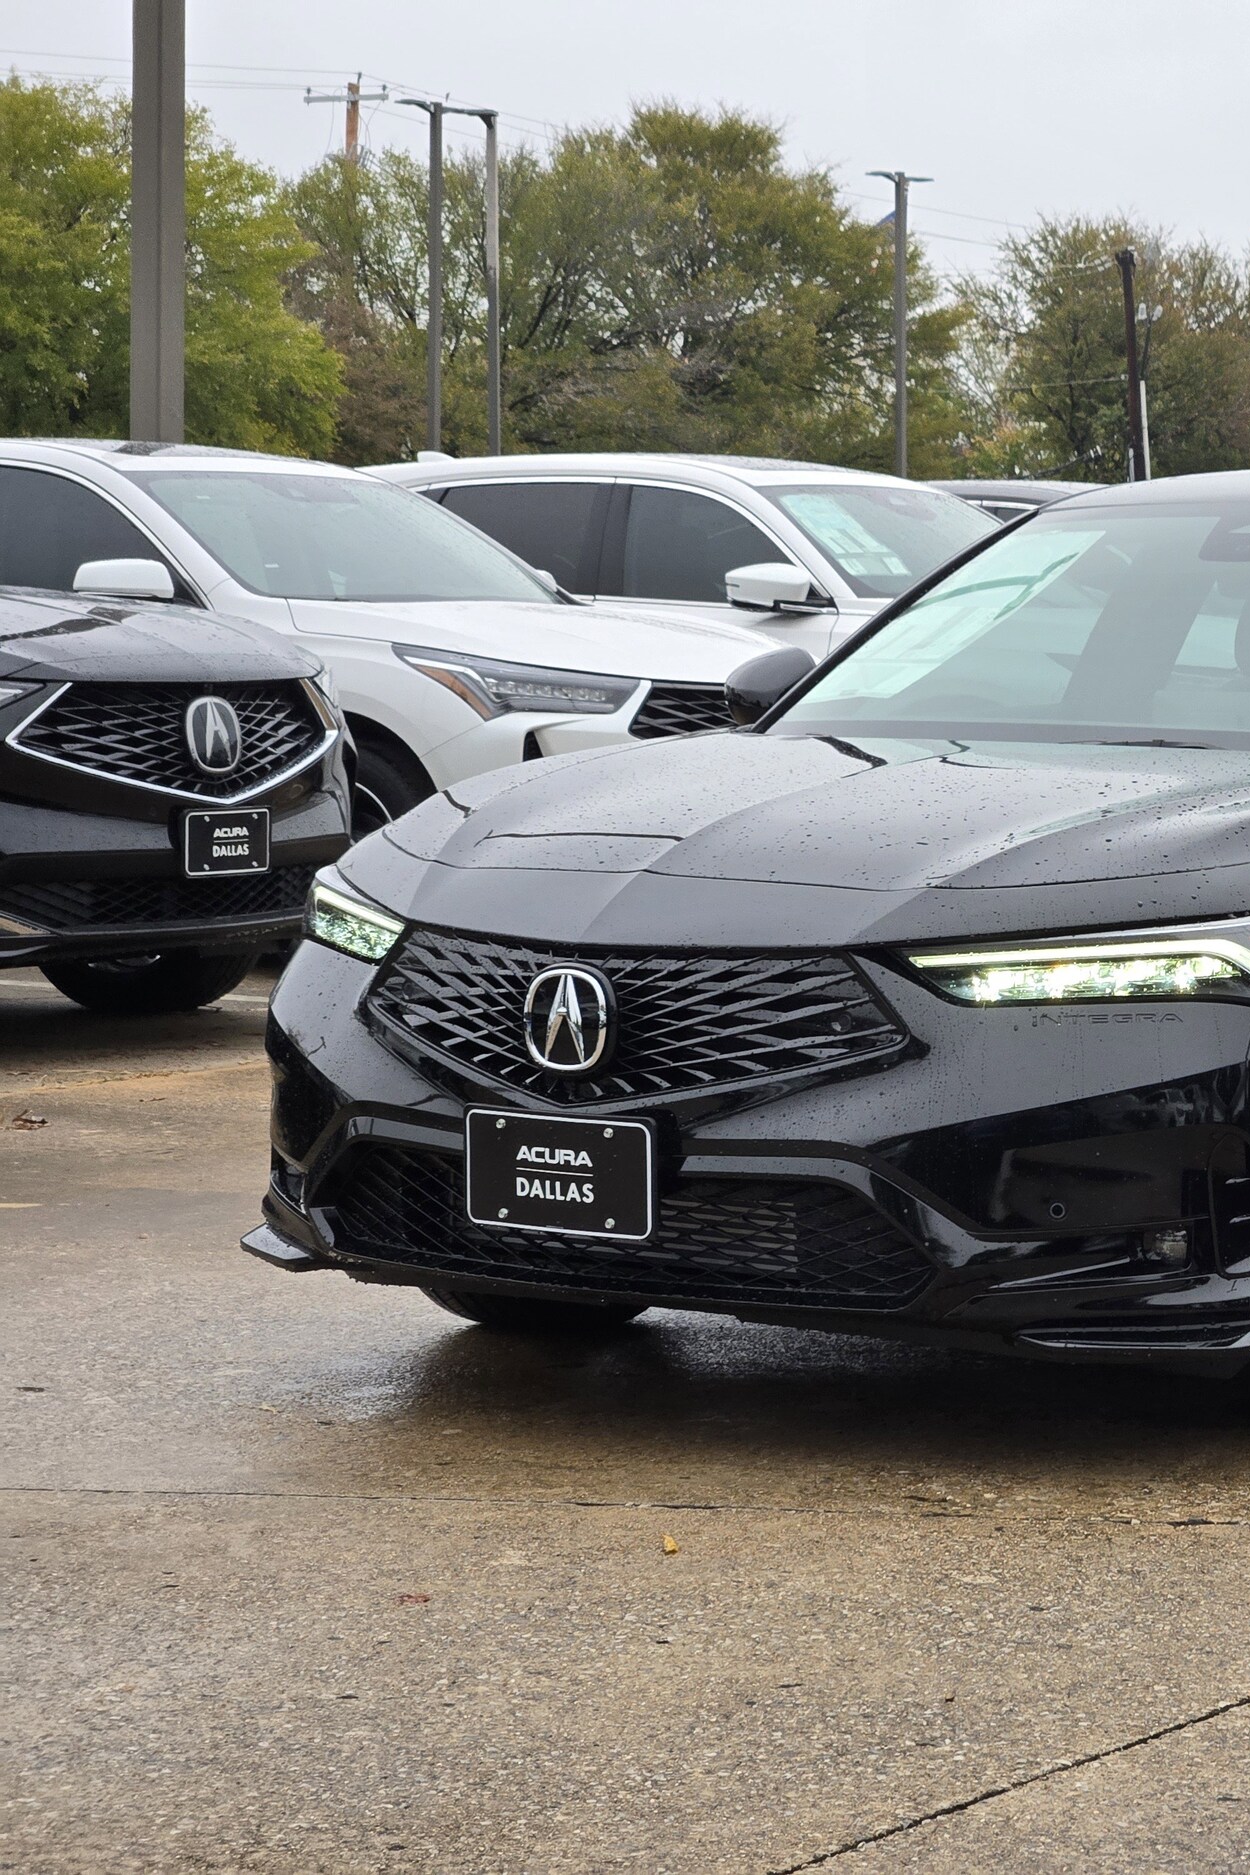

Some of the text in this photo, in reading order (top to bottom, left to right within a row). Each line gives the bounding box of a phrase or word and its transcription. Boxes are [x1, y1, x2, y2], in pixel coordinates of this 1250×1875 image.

[213, 826, 249, 838] ACURA
[212, 843, 250, 857] DALLAS
[1032, 1012, 1184, 1027] INTEGRA
[516, 1145, 593, 1167] ACURA
[516, 1176, 594, 1204] DALLAS
